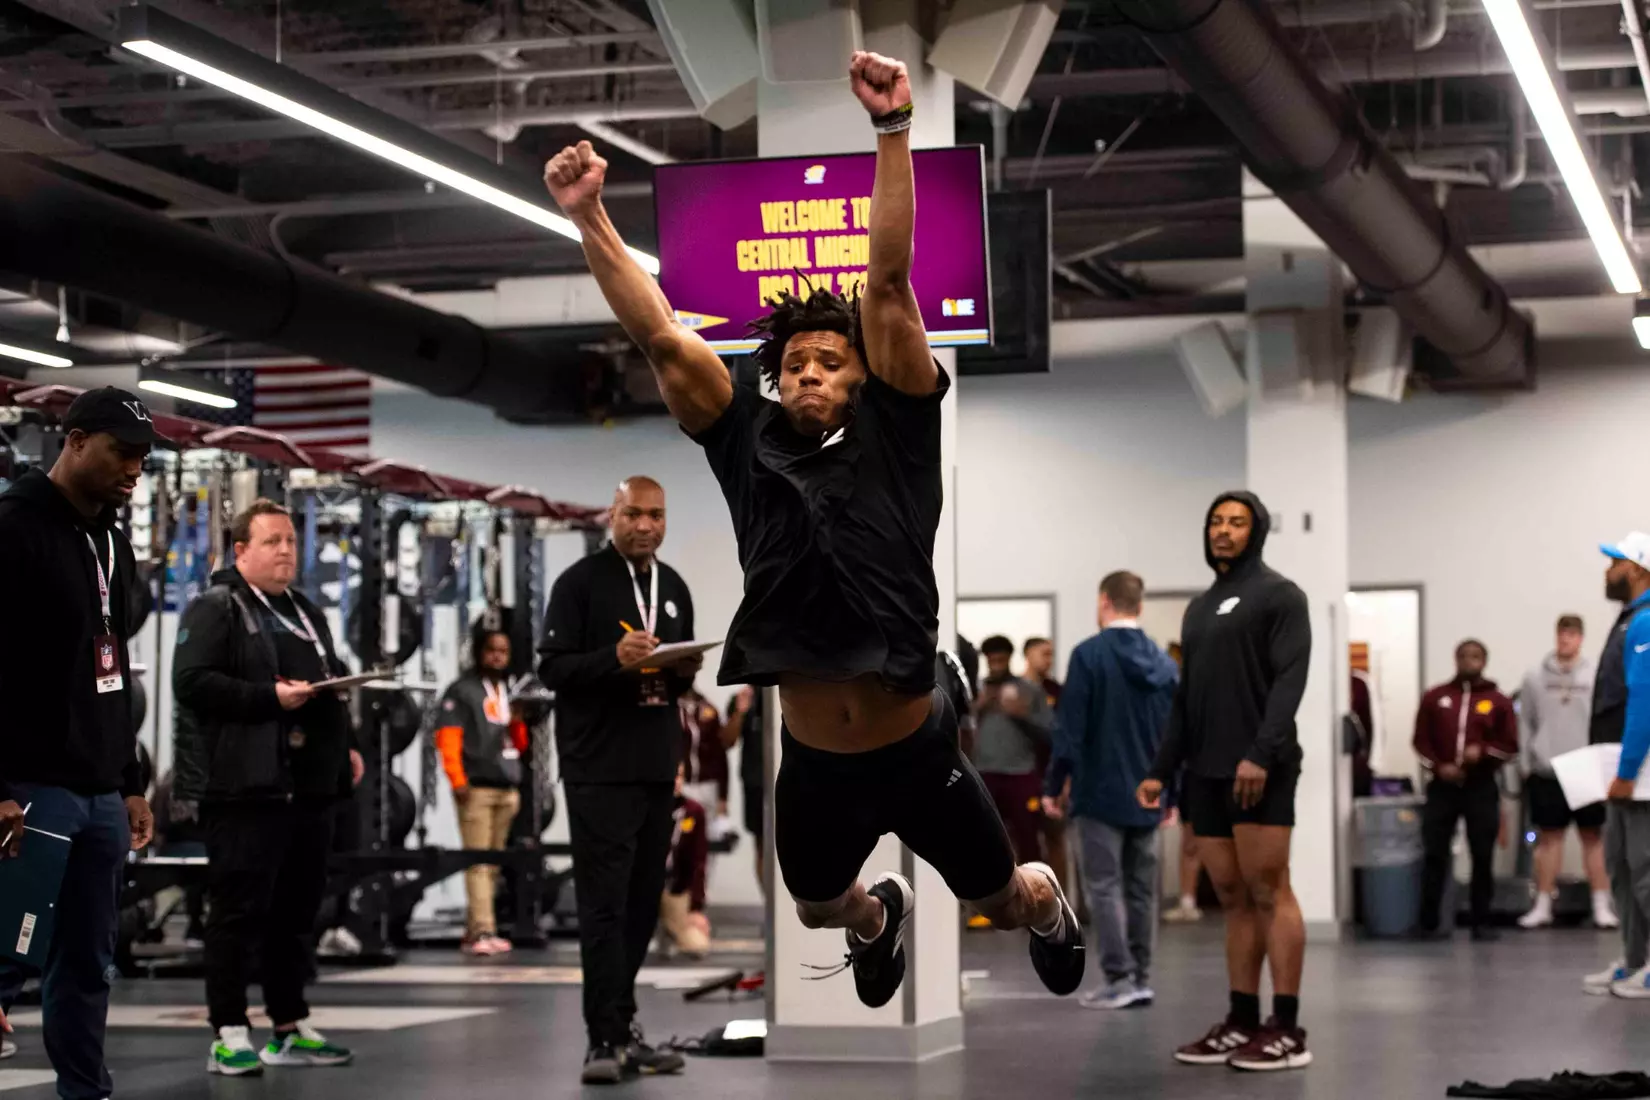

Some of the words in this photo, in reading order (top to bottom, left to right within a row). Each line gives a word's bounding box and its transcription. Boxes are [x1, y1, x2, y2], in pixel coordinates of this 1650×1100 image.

[760, 198, 848, 233] WELCOME
[850, 196, 871, 229] TO
[737, 237, 812, 271] CENTRAL
[815, 234, 870, 268] MICHI
